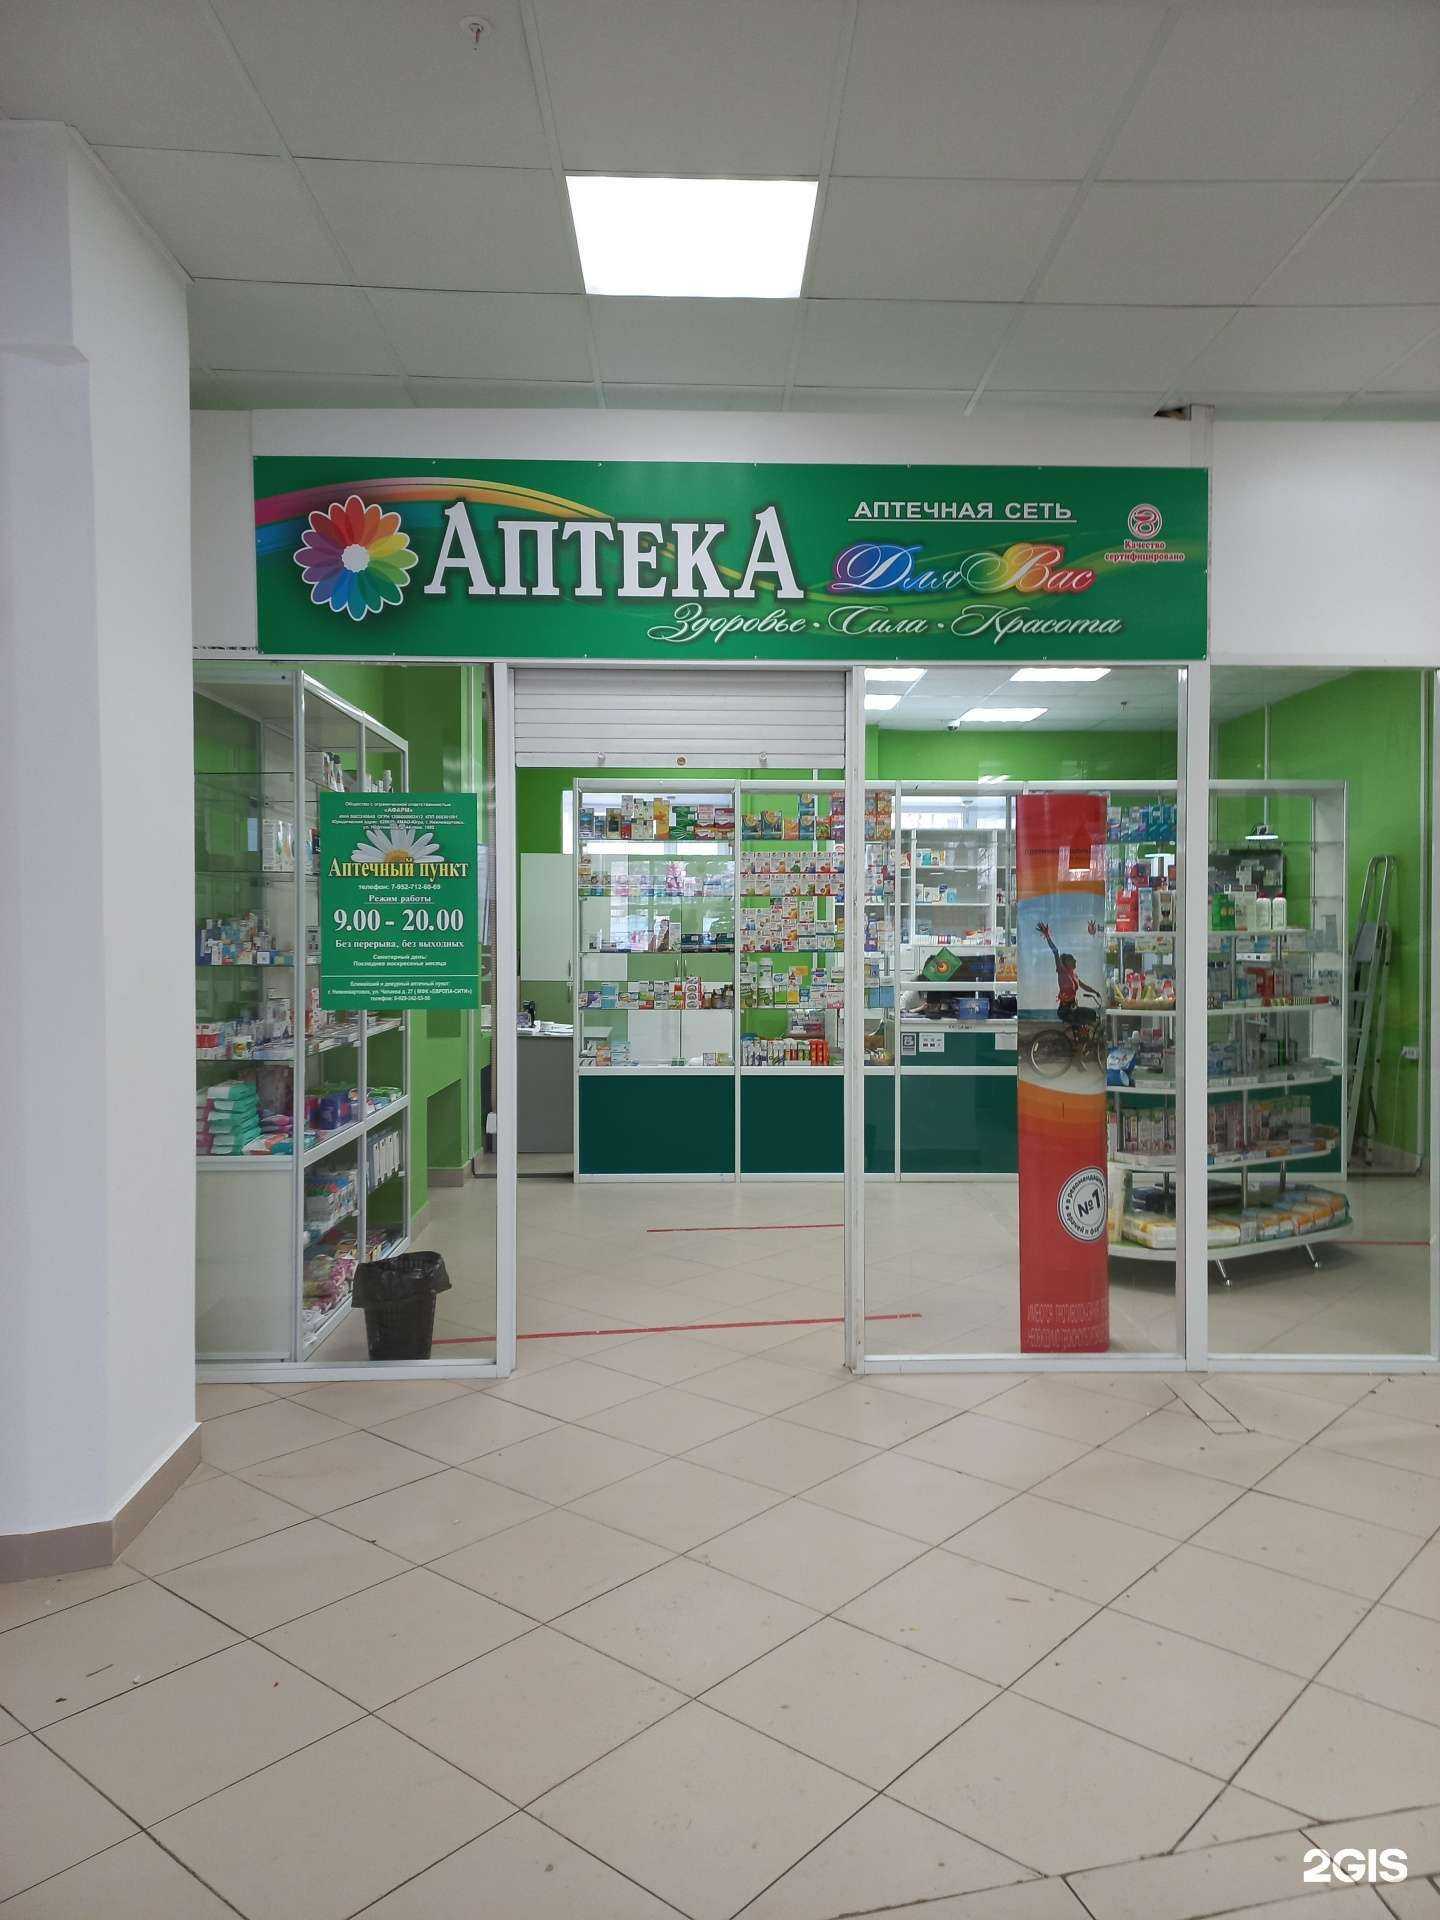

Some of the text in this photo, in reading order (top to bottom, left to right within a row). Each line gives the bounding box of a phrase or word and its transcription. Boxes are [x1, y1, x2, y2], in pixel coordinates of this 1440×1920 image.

[854, 501, 1072, 520] АПТЕЧНАЯ СЕТЬ
[423, 501, 804, 598] АПТЕКА
[832, 544, 1093, 594] Для Вас
[647, 602, 1123, 645] Здоровье Сила Красота
[328, 857, 468, 882] Аптечный пункт
[368, 894, 432, 904] Режим работы
[334, 908, 381, 932] 9.00
[402, 908, 464, 932] 20.00
[335, 940, 351, 948] Без
[401, 940, 417, 948] без
[419, 940, 465, 948] выходных
[1077, 1188, 1101, 1218] №1
